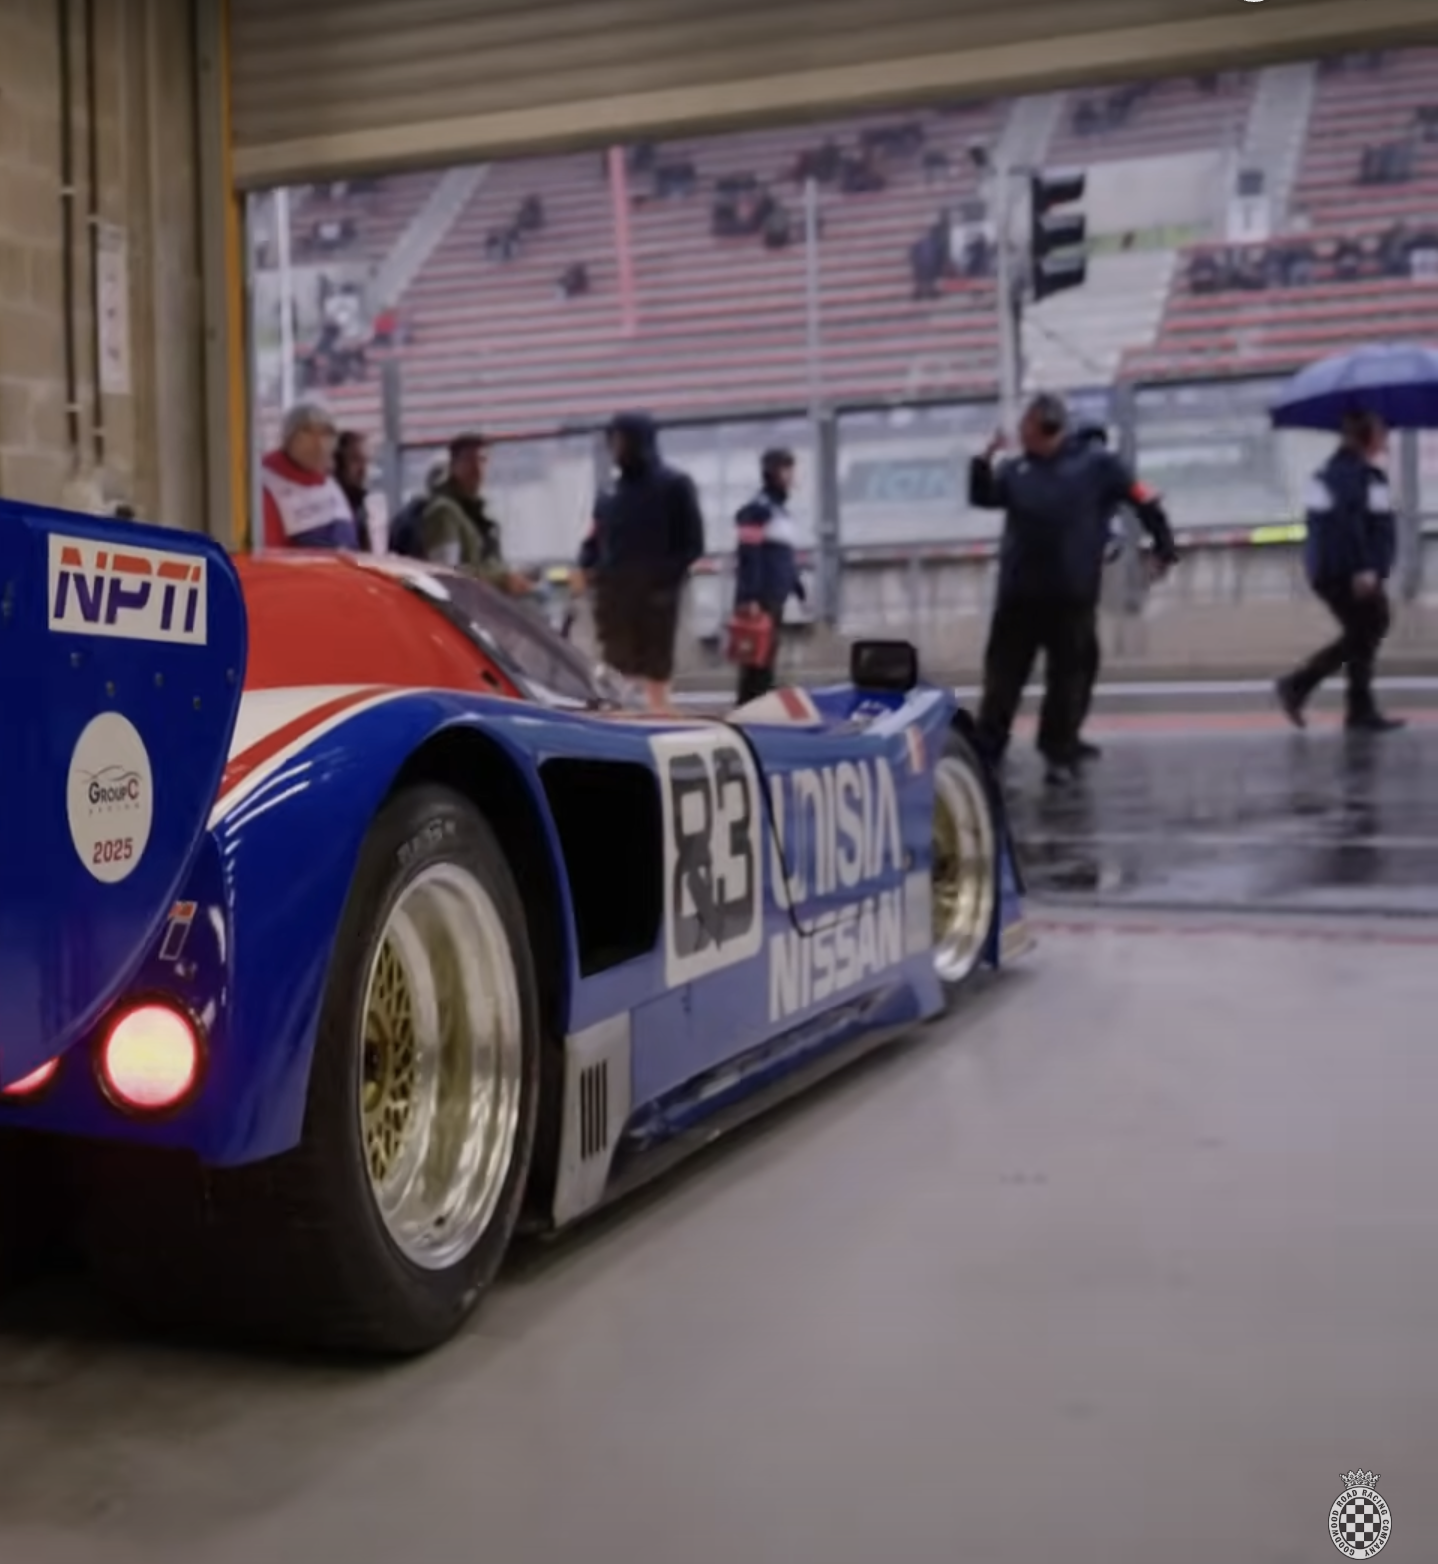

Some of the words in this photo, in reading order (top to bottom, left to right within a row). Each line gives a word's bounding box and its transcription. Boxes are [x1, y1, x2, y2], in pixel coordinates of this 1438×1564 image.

[92, 837, 133, 865] 2025
[668, 746, 755, 960] 83
[769, 886, 903, 1024] NISSAN
